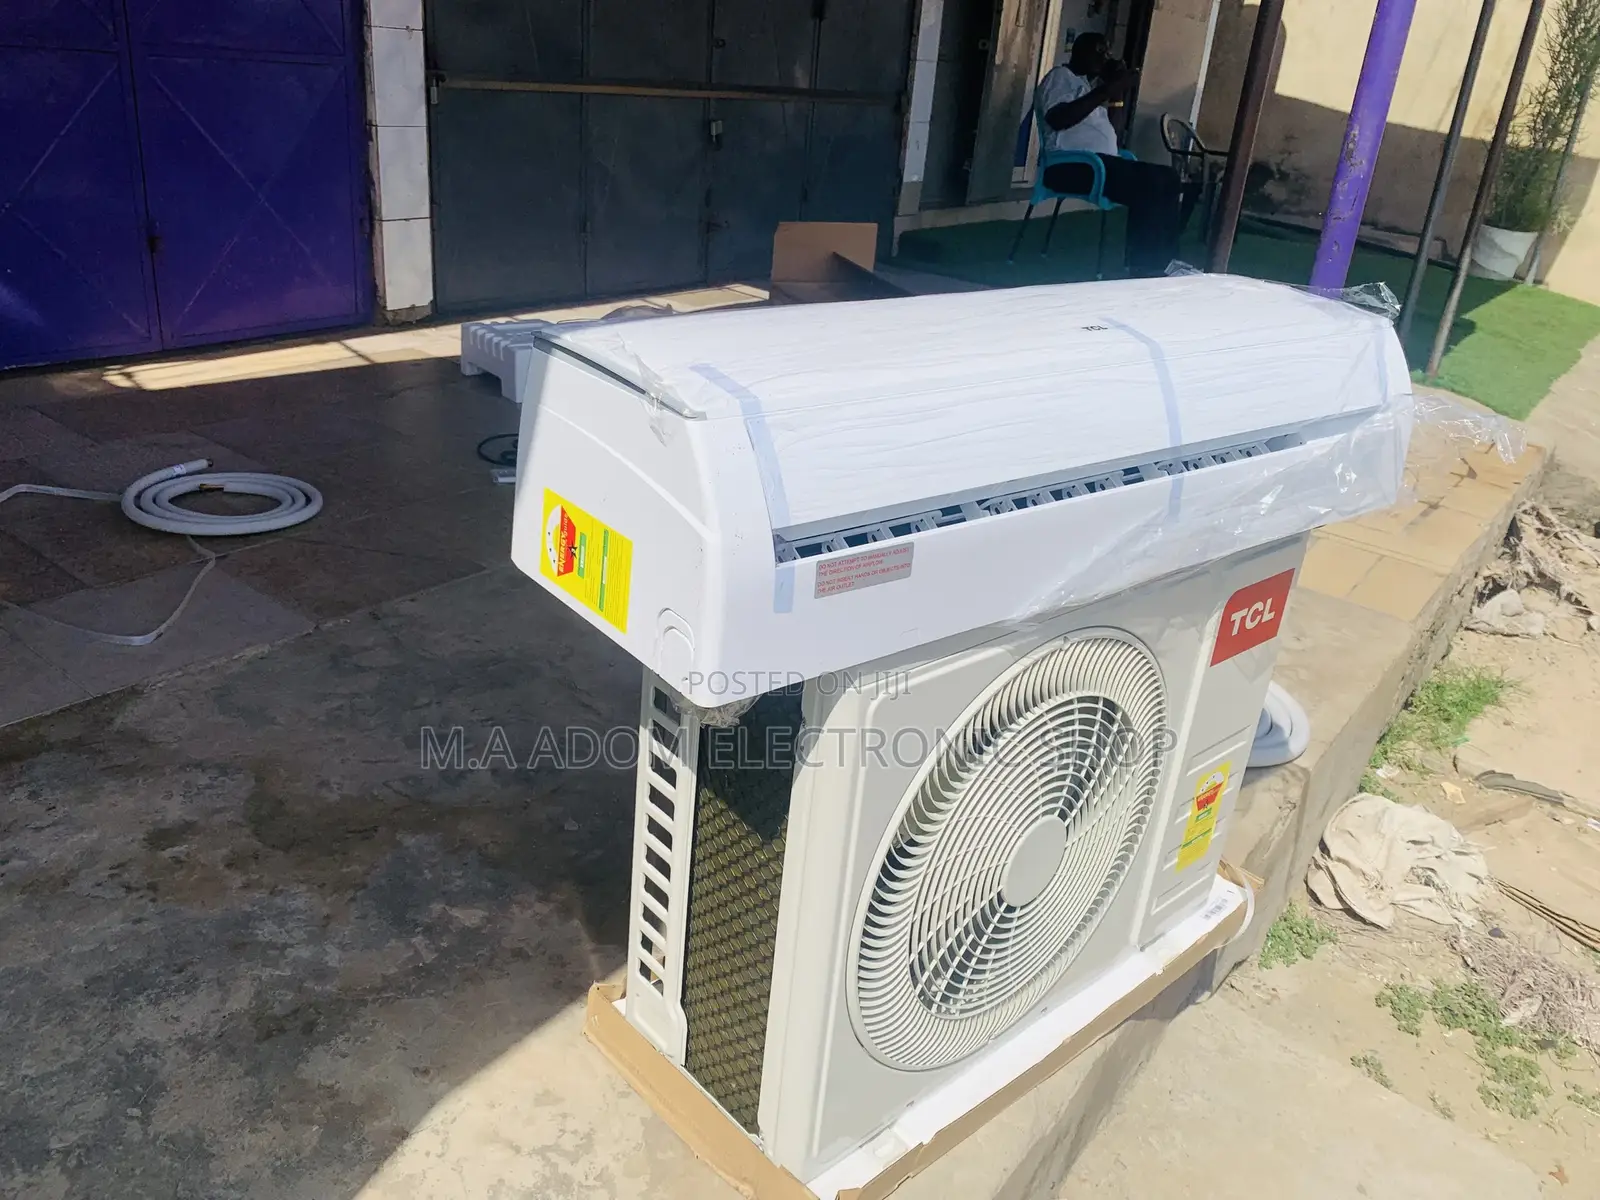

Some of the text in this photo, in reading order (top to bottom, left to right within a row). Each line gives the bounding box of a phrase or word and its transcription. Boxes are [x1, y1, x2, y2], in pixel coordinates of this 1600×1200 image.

[558, 531, 568, 573] ENERGY
[827, 561, 838, 569] NOT
[838, 557, 860, 566] ATTEMPT
[868, 550, 892, 560] MANUALLY
[893, 547, 909, 556] ADJUST
[818, 569, 828, 577] THE
[828, 564, 855, 575] DIRECTION
[837, 575, 854, 583] INSERT
[854, 571, 871, 579] HANDS
[879, 564, 900, 574] OBJECTS
[827, 584, 836, 592] AIR
[1231, 597, 1276, 636] TCL
